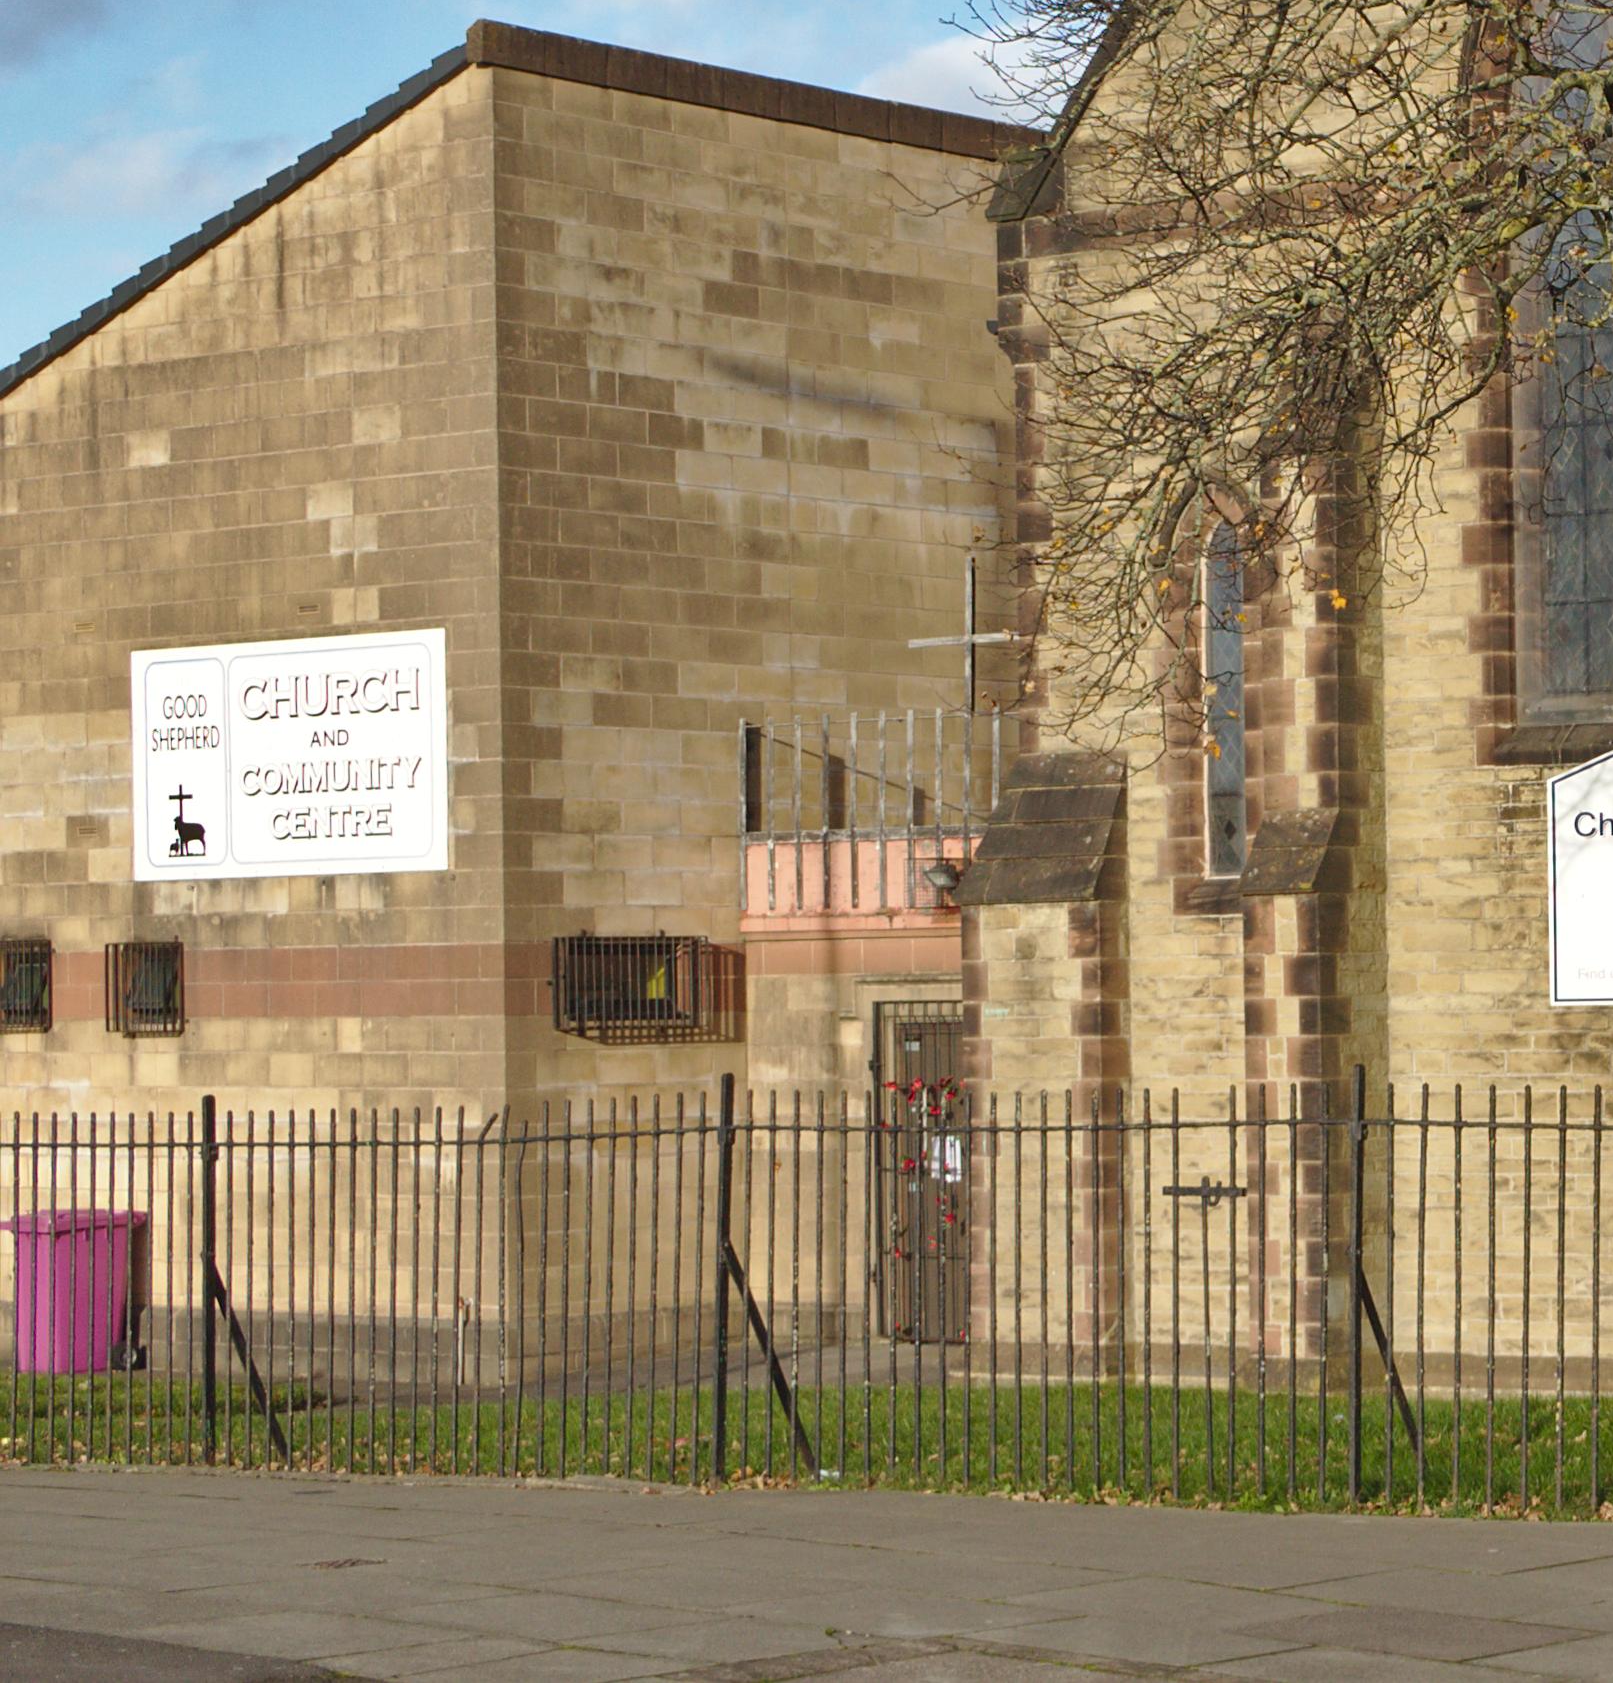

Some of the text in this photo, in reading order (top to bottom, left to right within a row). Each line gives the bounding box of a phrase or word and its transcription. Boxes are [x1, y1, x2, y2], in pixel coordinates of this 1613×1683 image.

[163, 695, 206, 719] GOOD
[241, 667, 420, 722] CHURCH
[152, 726, 219, 751] SHEPHERD
[311, 730, 349, 747] AND
[243, 756, 422, 797] COMMUNITY
[273, 803, 393, 841] CENTRE
[1578, 969, 1605, 979] Find
